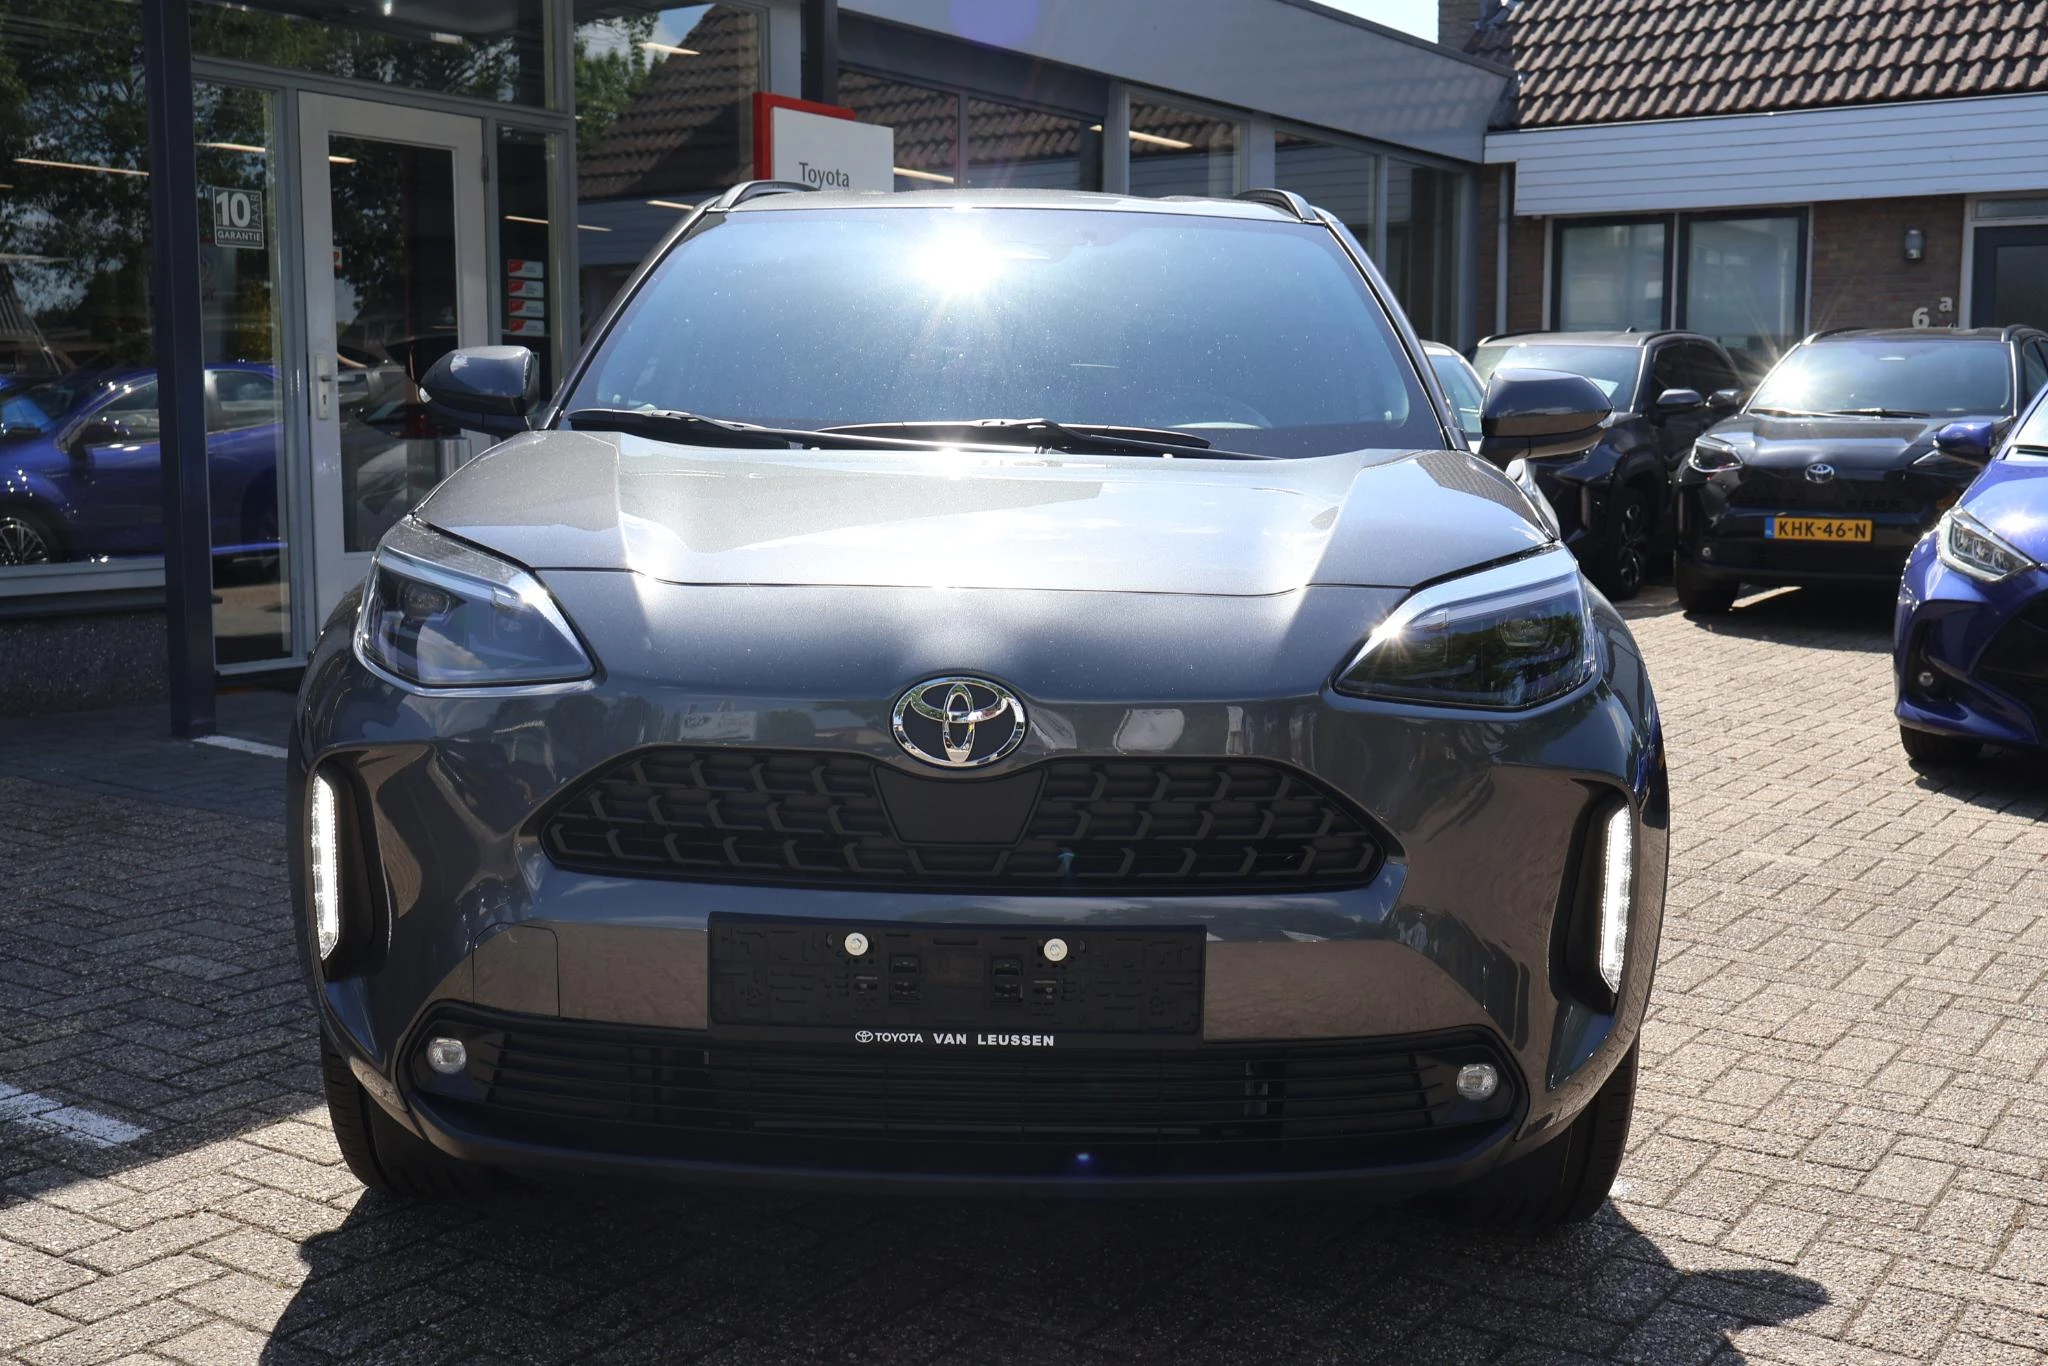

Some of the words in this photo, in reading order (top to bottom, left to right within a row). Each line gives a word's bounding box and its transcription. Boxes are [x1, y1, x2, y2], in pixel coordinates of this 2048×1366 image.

[798, 161, 850, 190] Toyota
[215, 191, 251, 228] 10
[217, 230, 261, 241] GARANTIE
[1912, 306, 1930, 329] 6
[1938, 296, 1953, 312] a
[1779, 520, 1867, 539] KHK-46-N
[875, 1032, 924, 1043] TOYOTA
[933, 1033, 967, 1045] VAN
[977, 1034, 1055, 1047] LEUSSEN
